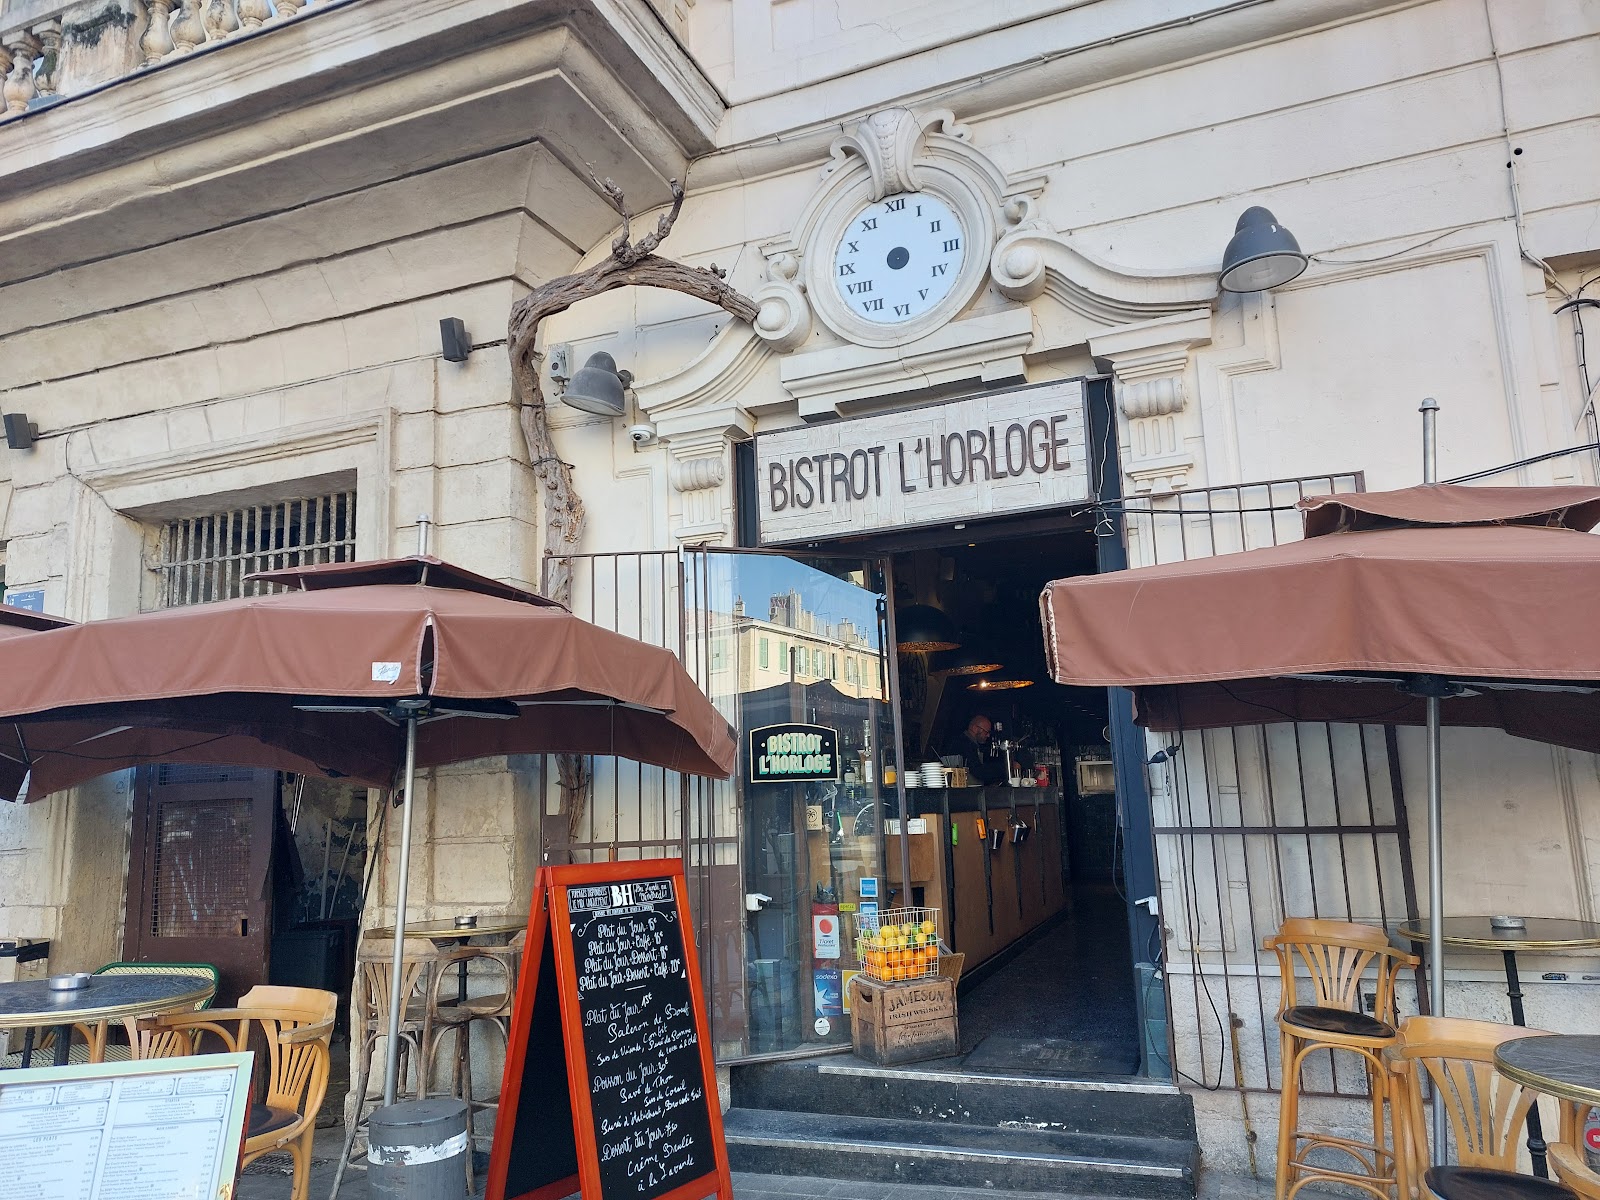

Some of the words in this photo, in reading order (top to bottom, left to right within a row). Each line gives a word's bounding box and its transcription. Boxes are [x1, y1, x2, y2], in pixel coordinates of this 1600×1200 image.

[885, 198, 906, 213] XII
[916, 205, 922, 217] I
[861, 218, 878, 232] XI
[930, 220, 941, 233] II
[848, 241, 859, 253] X
[943, 238, 960, 253] III
[839, 263, 856, 276] IX
[931, 263, 949, 277] IV
[846, 280, 873, 295] VIII
[918, 288, 929, 301] V
[862, 298, 884, 312] VII
[893, 303, 911, 316] VI
[769, 445, 886, 512] BISTROT
[898, 414, 1070, 493] L'HORLOGE
[767, 732, 823, 755] BISTROT
[759, 754, 831, 775] L'HORLOGE
[610, 884, 634, 907] BH
[598, 924, 614, 938] Plat
[617, 922, 627, 935] du
[588, 941, 605, 956] Plat
[606, 940, 616, 953] du
[584, 957, 602, 974] Plat
[603, 956, 613, 970] du
[580, 975, 597, 991] Plat
[598, 974, 609, 988] du
[888, 989, 946, 1012] JAMESON
[610, 1002, 622, 1020] du
[889, 1010, 912, 1020] IRISH
[654, 1014, 663, 1025] de
[626, 1067, 637, 1082] du
[602, 1136, 633, 1160] Dessert
[634, 1131, 645, 1148] du
[649, 1172, 658, 1187] la
